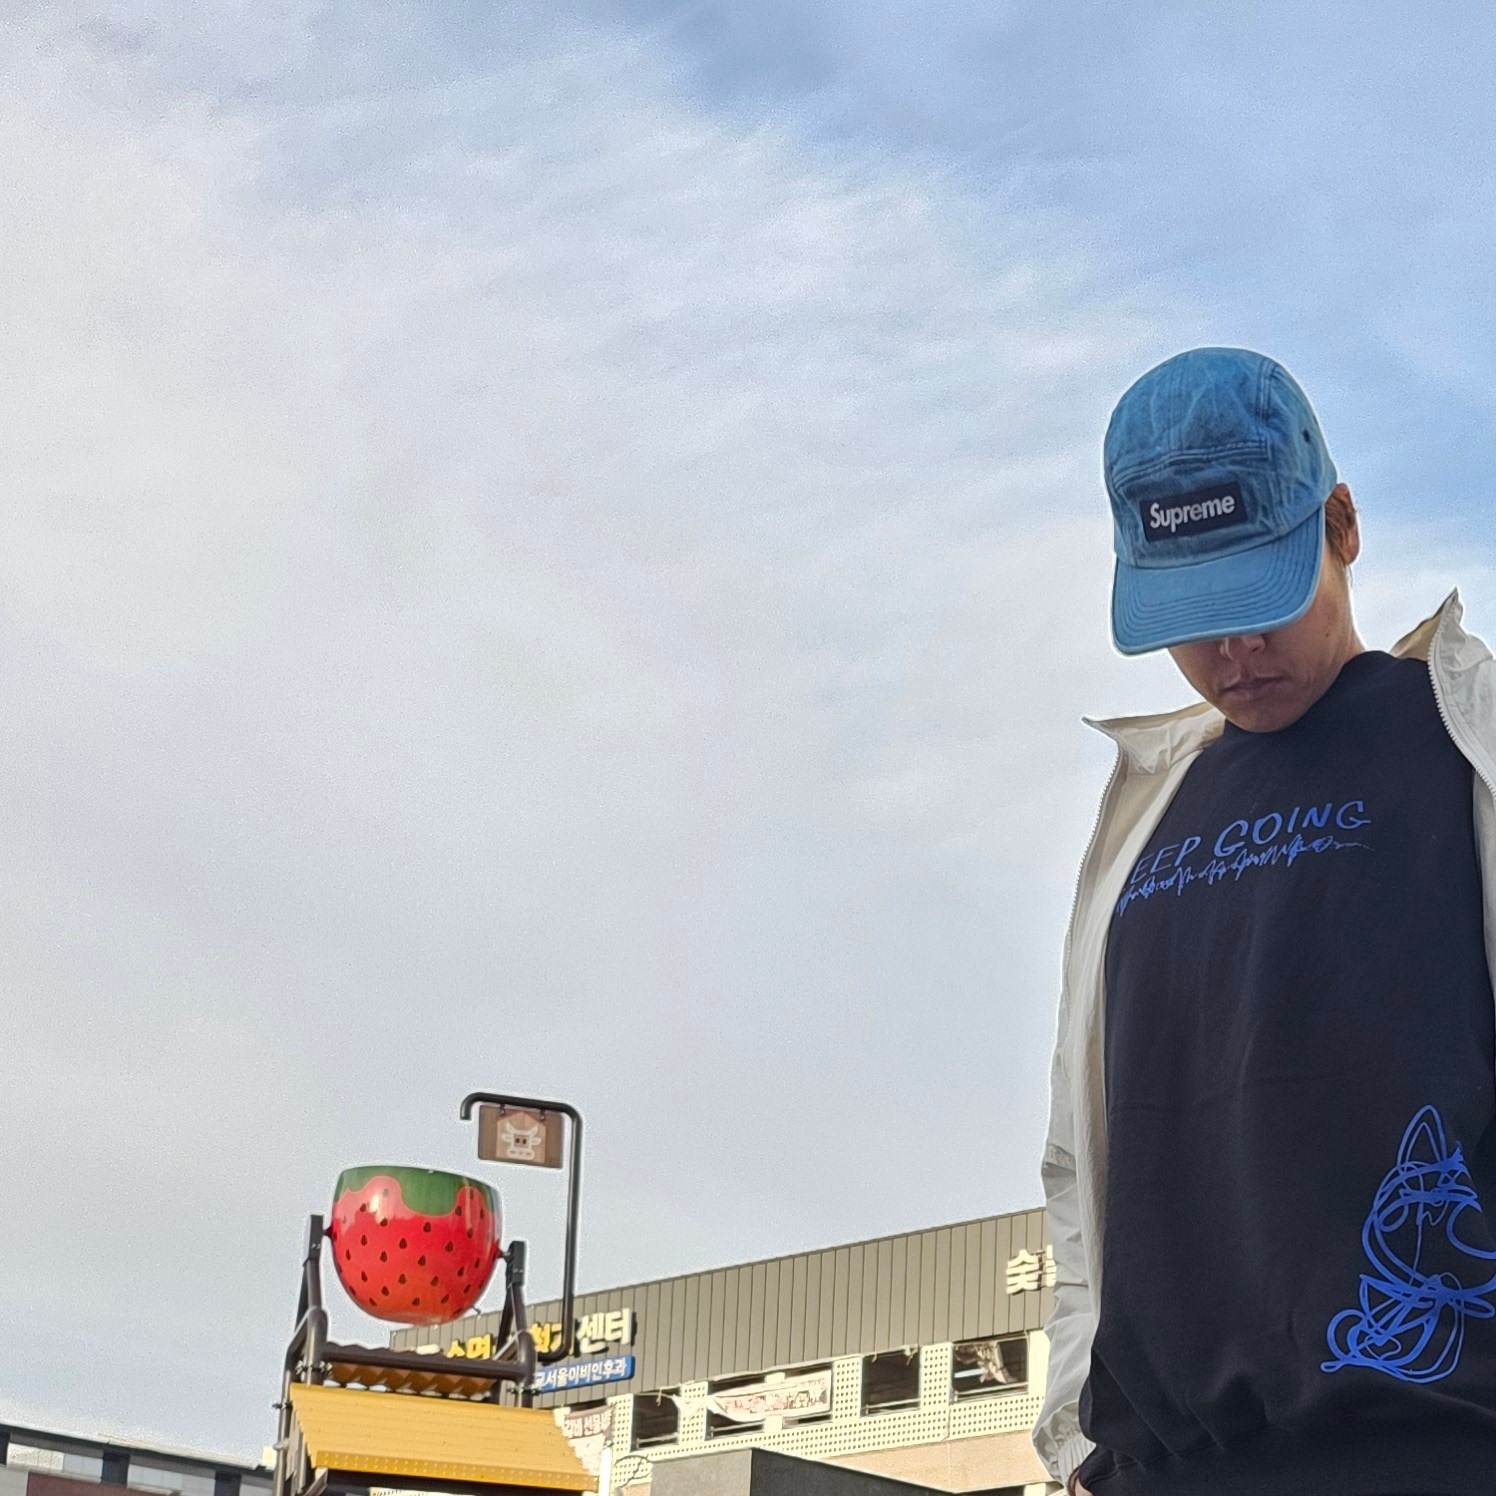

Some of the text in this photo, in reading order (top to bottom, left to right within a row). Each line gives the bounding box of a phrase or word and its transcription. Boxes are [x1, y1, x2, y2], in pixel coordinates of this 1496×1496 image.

[1149, 495, 1236, 533] Supreme
[1130, 836, 1202, 885] EEP
[1213, 800, 1371, 858] GOING
[576, 1307, 631, 1354] 센터
[530, 1357, 628, 1389] 교서울이비인후과
